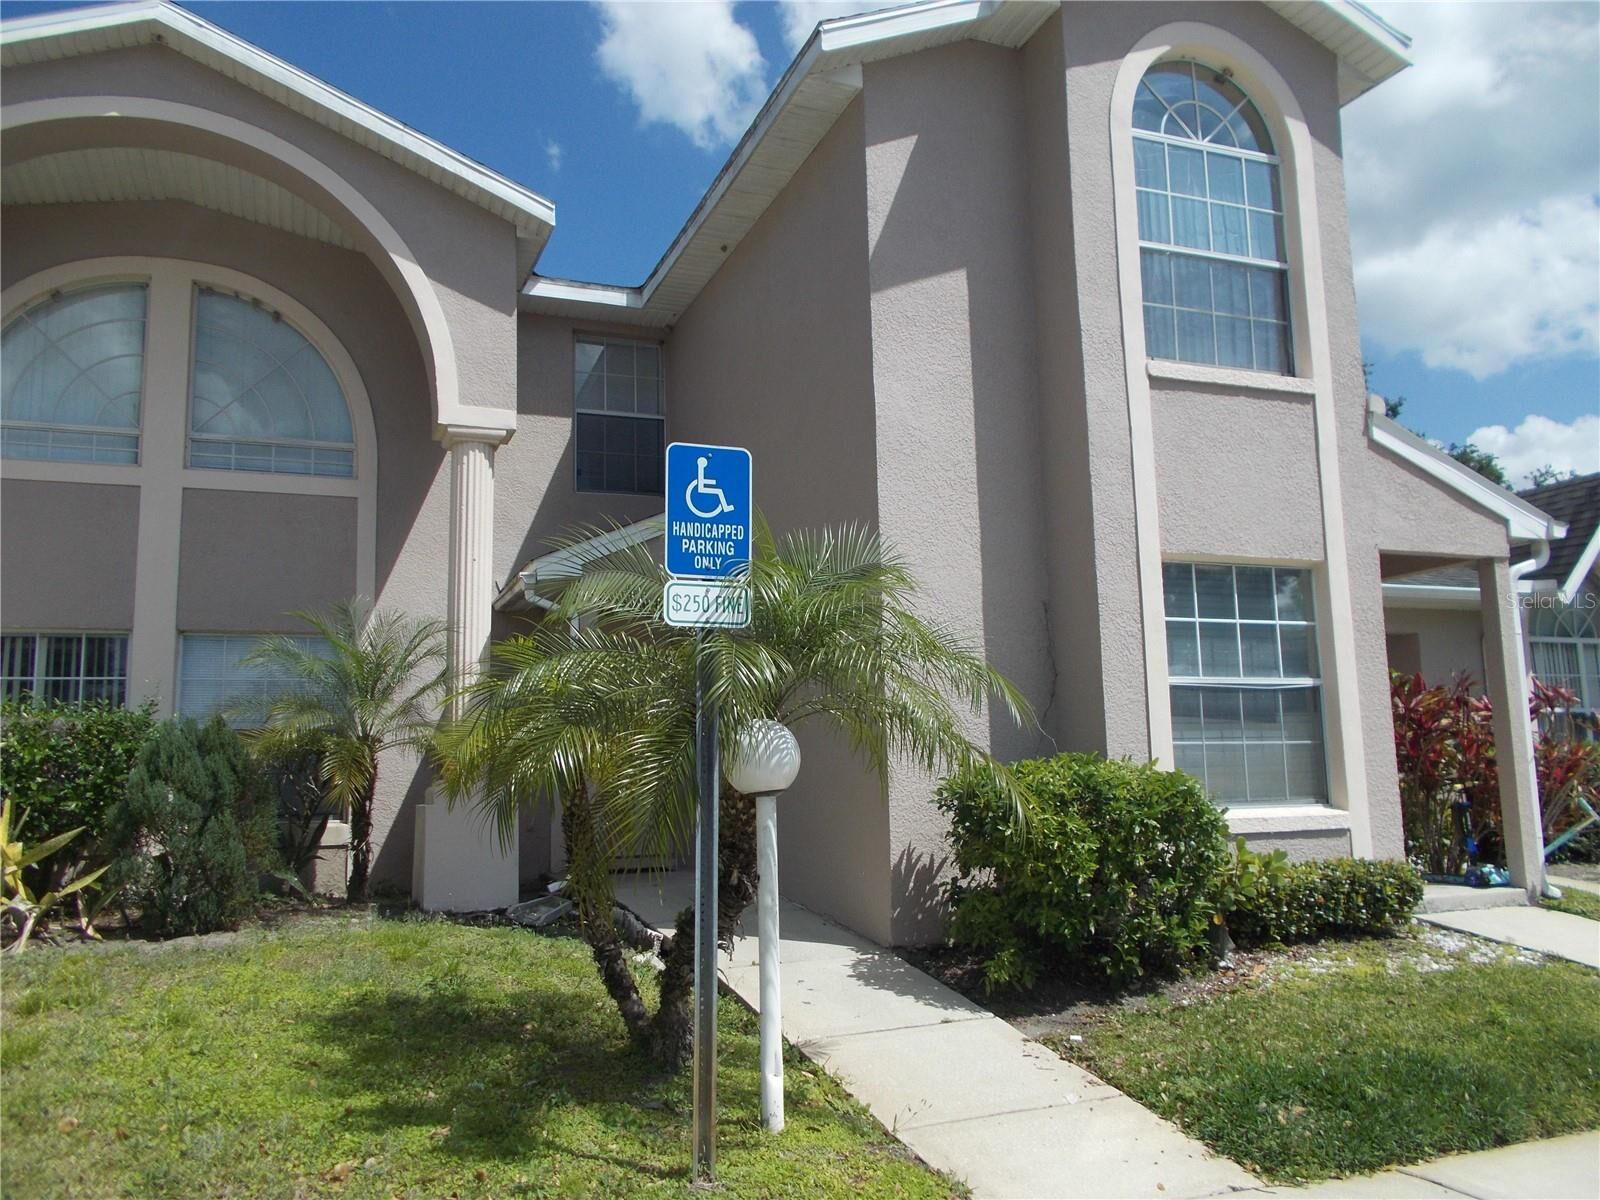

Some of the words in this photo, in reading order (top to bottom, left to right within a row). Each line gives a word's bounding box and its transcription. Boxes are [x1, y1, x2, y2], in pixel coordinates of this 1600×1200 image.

[672, 521, 744, 540] HANDICAPPED
[682, 539, 735, 555] PARKING
[694, 555, 722, 570] ONLY
[671, 593, 710, 614] $250
[715, 595, 744, 614] FINE
